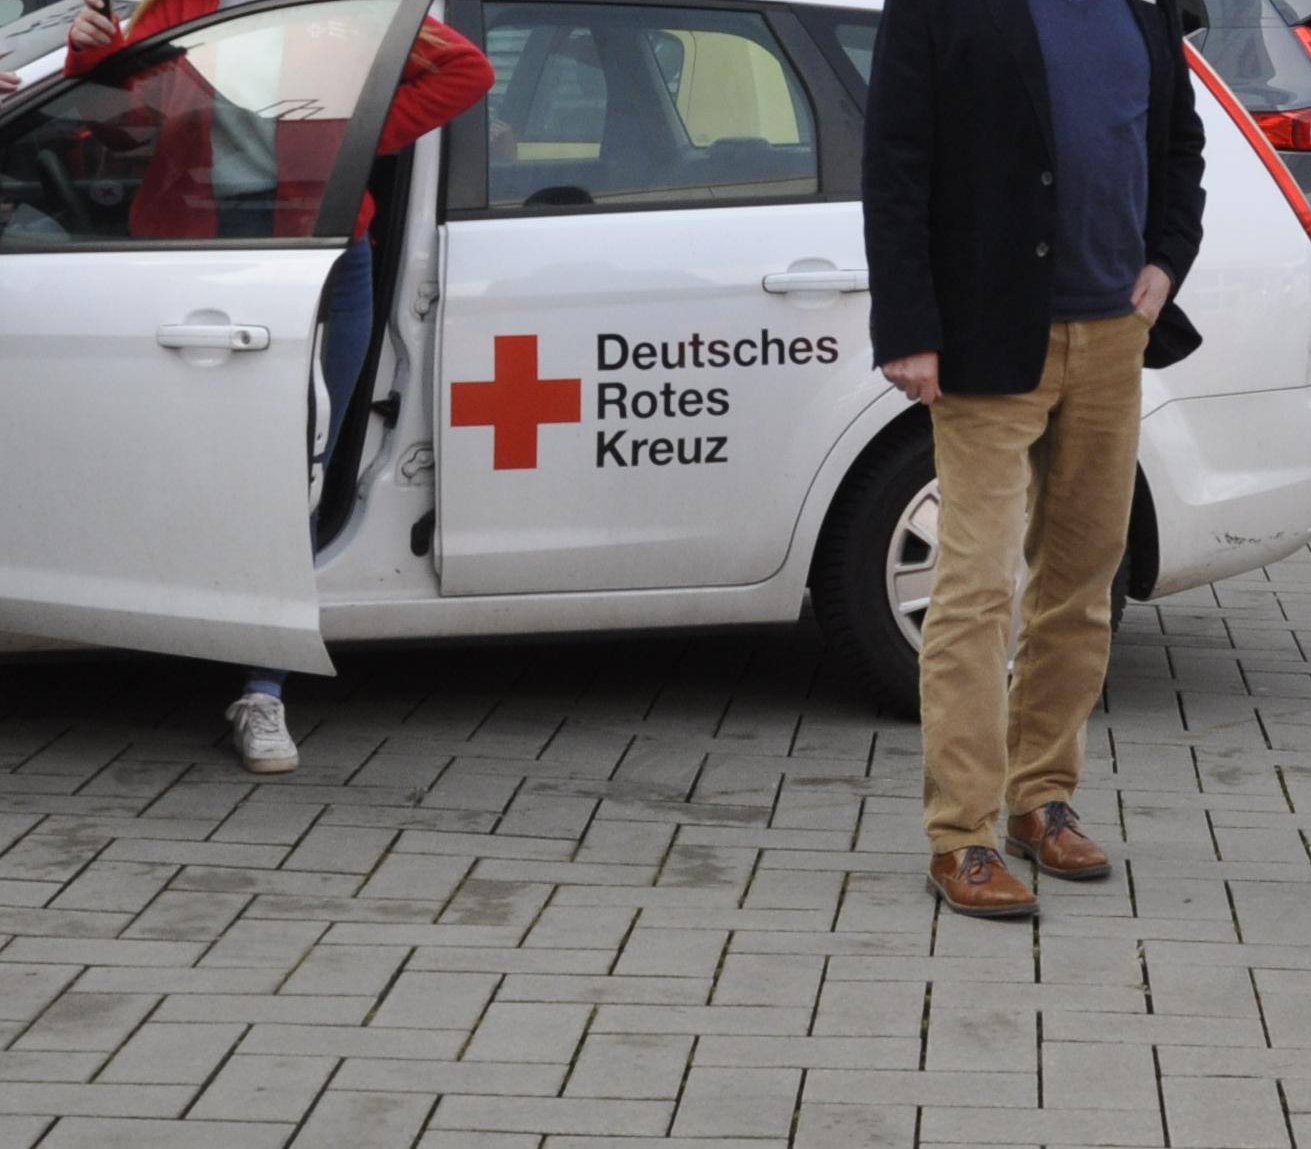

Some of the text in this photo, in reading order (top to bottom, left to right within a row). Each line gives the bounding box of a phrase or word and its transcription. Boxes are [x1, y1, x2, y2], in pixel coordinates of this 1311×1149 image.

[597, 329, 839, 371] Deutsches
[597, 382, 730, 420] Rotes
[596, 430, 729, 468] Kreuz
